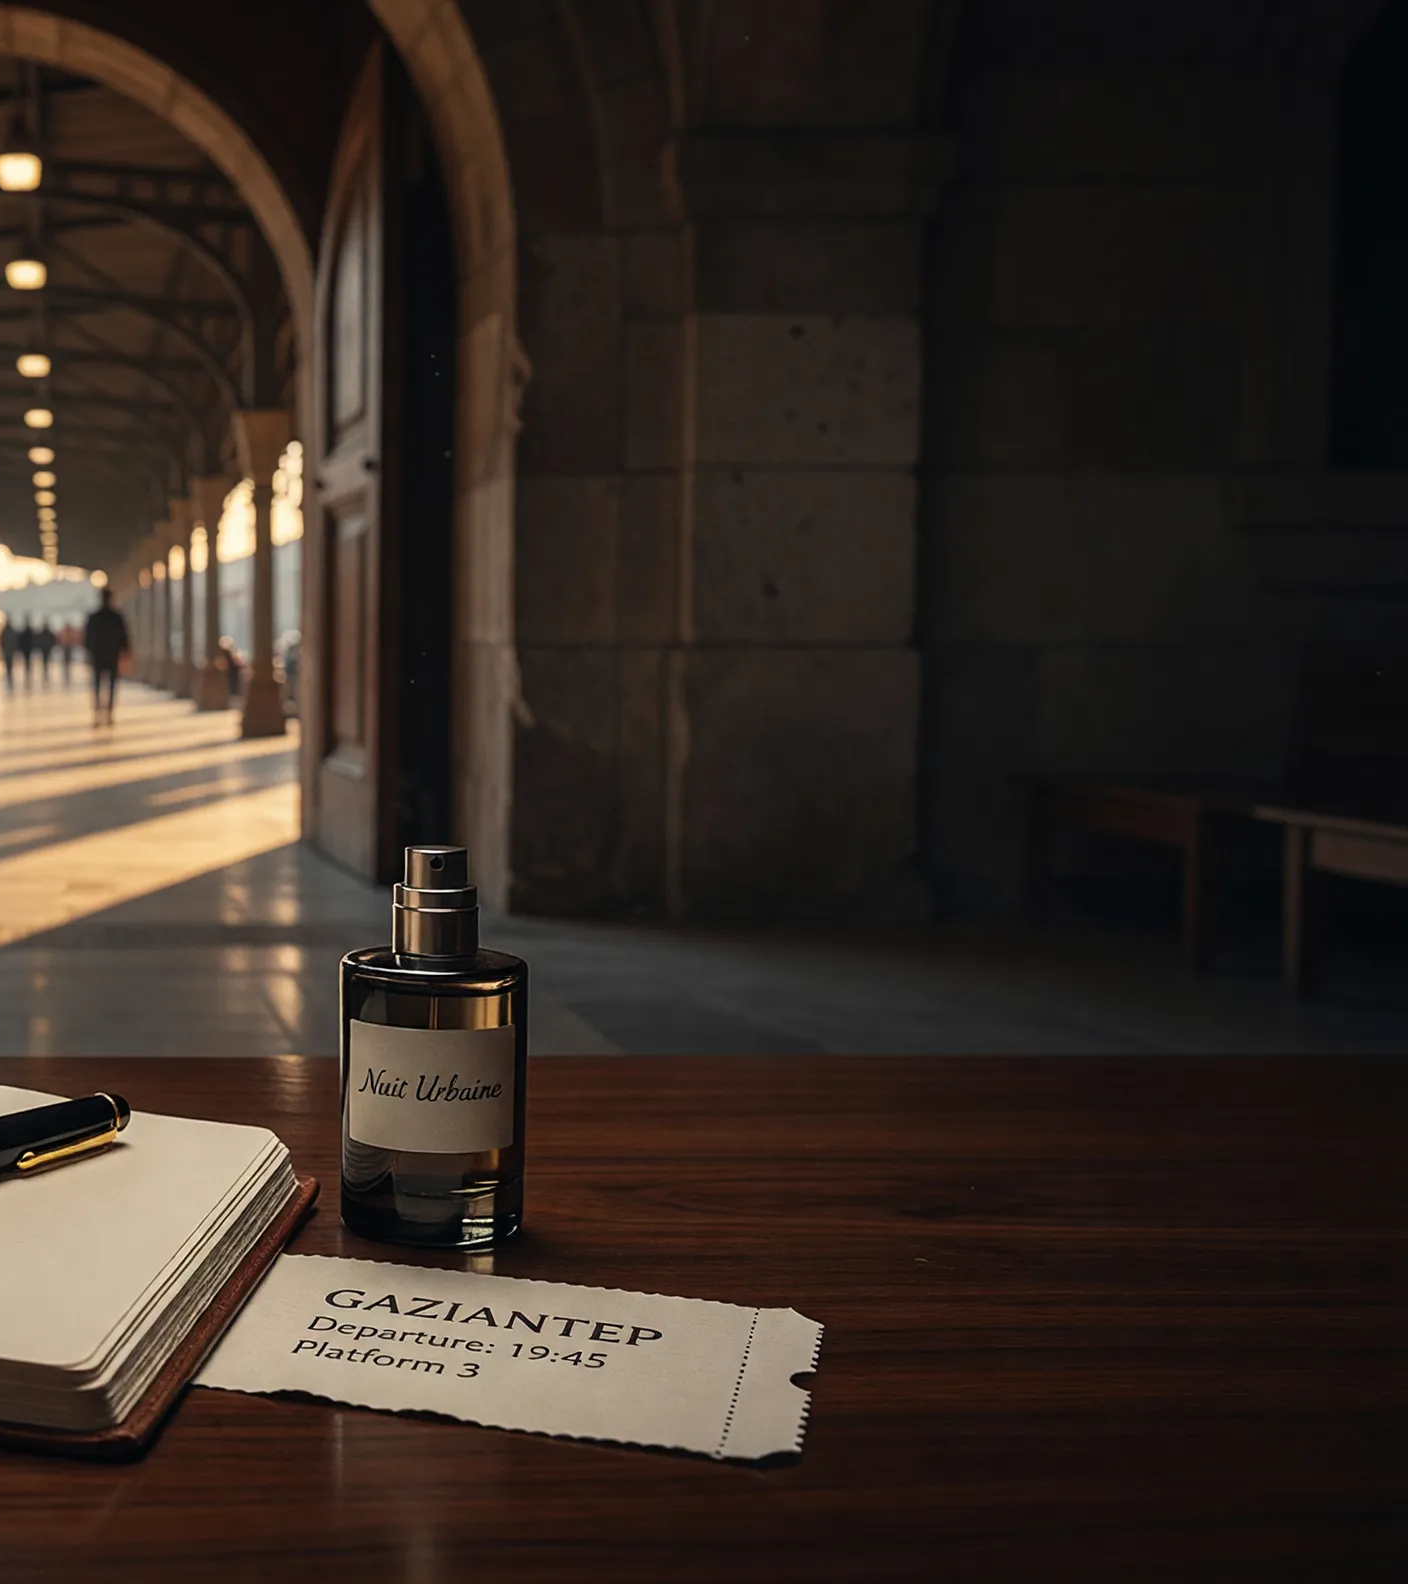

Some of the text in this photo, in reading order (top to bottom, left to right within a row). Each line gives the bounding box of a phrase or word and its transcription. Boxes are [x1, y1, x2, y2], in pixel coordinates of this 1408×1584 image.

[358, 1068, 503, 1102] Nuit Urbaine
[324, 1288, 664, 1347] GAZIANTEP
[291, 1339, 480, 1379] Platform 3
[307, 1315, 608, 1370] Departure: 19:45
